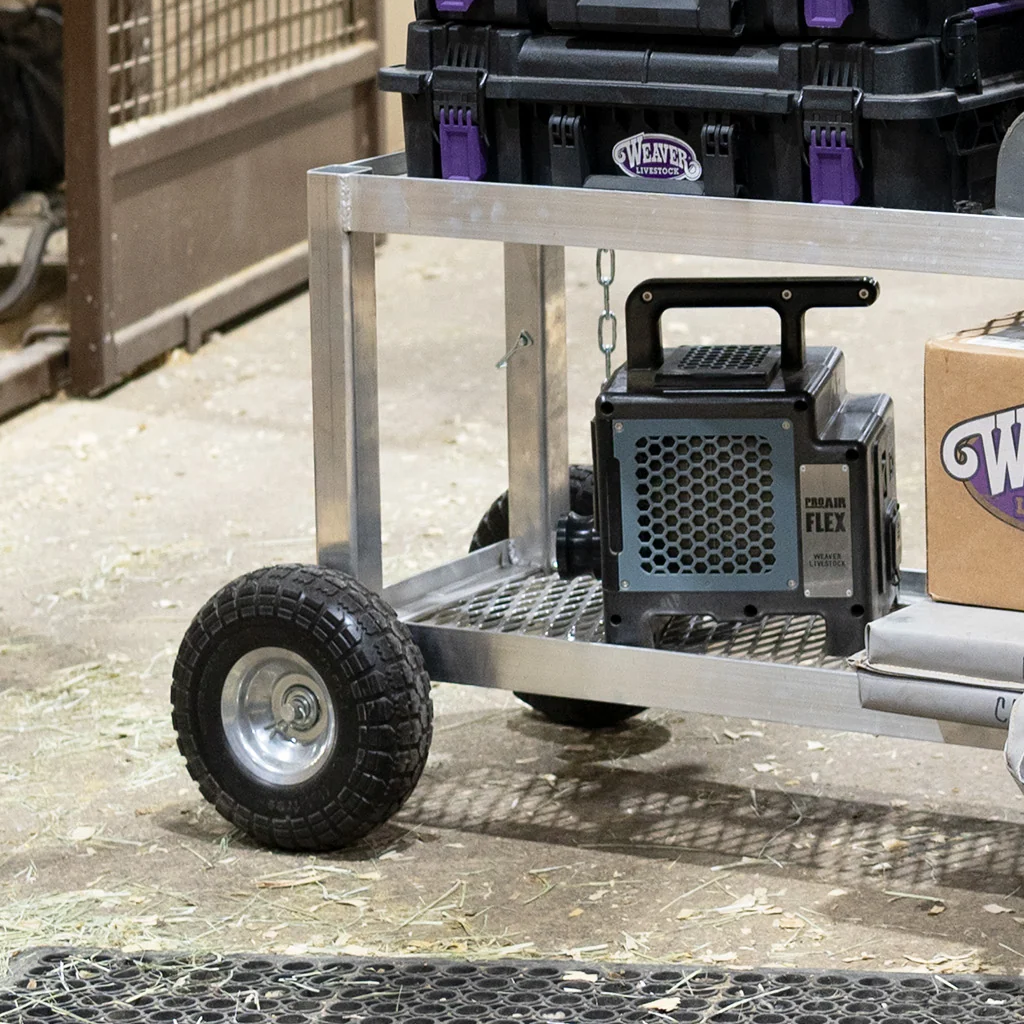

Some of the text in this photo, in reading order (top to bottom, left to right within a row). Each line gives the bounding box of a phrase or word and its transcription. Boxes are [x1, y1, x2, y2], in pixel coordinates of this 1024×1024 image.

[612, 133, 702, 181] WEAVER
[636, 166, 680, 176] LIVESTOCK
[804, 496, 846, 509] PROAIR
[805, 511, 847, 533] FLEX
[808, 560, 846, 568] LIVESTOCK
